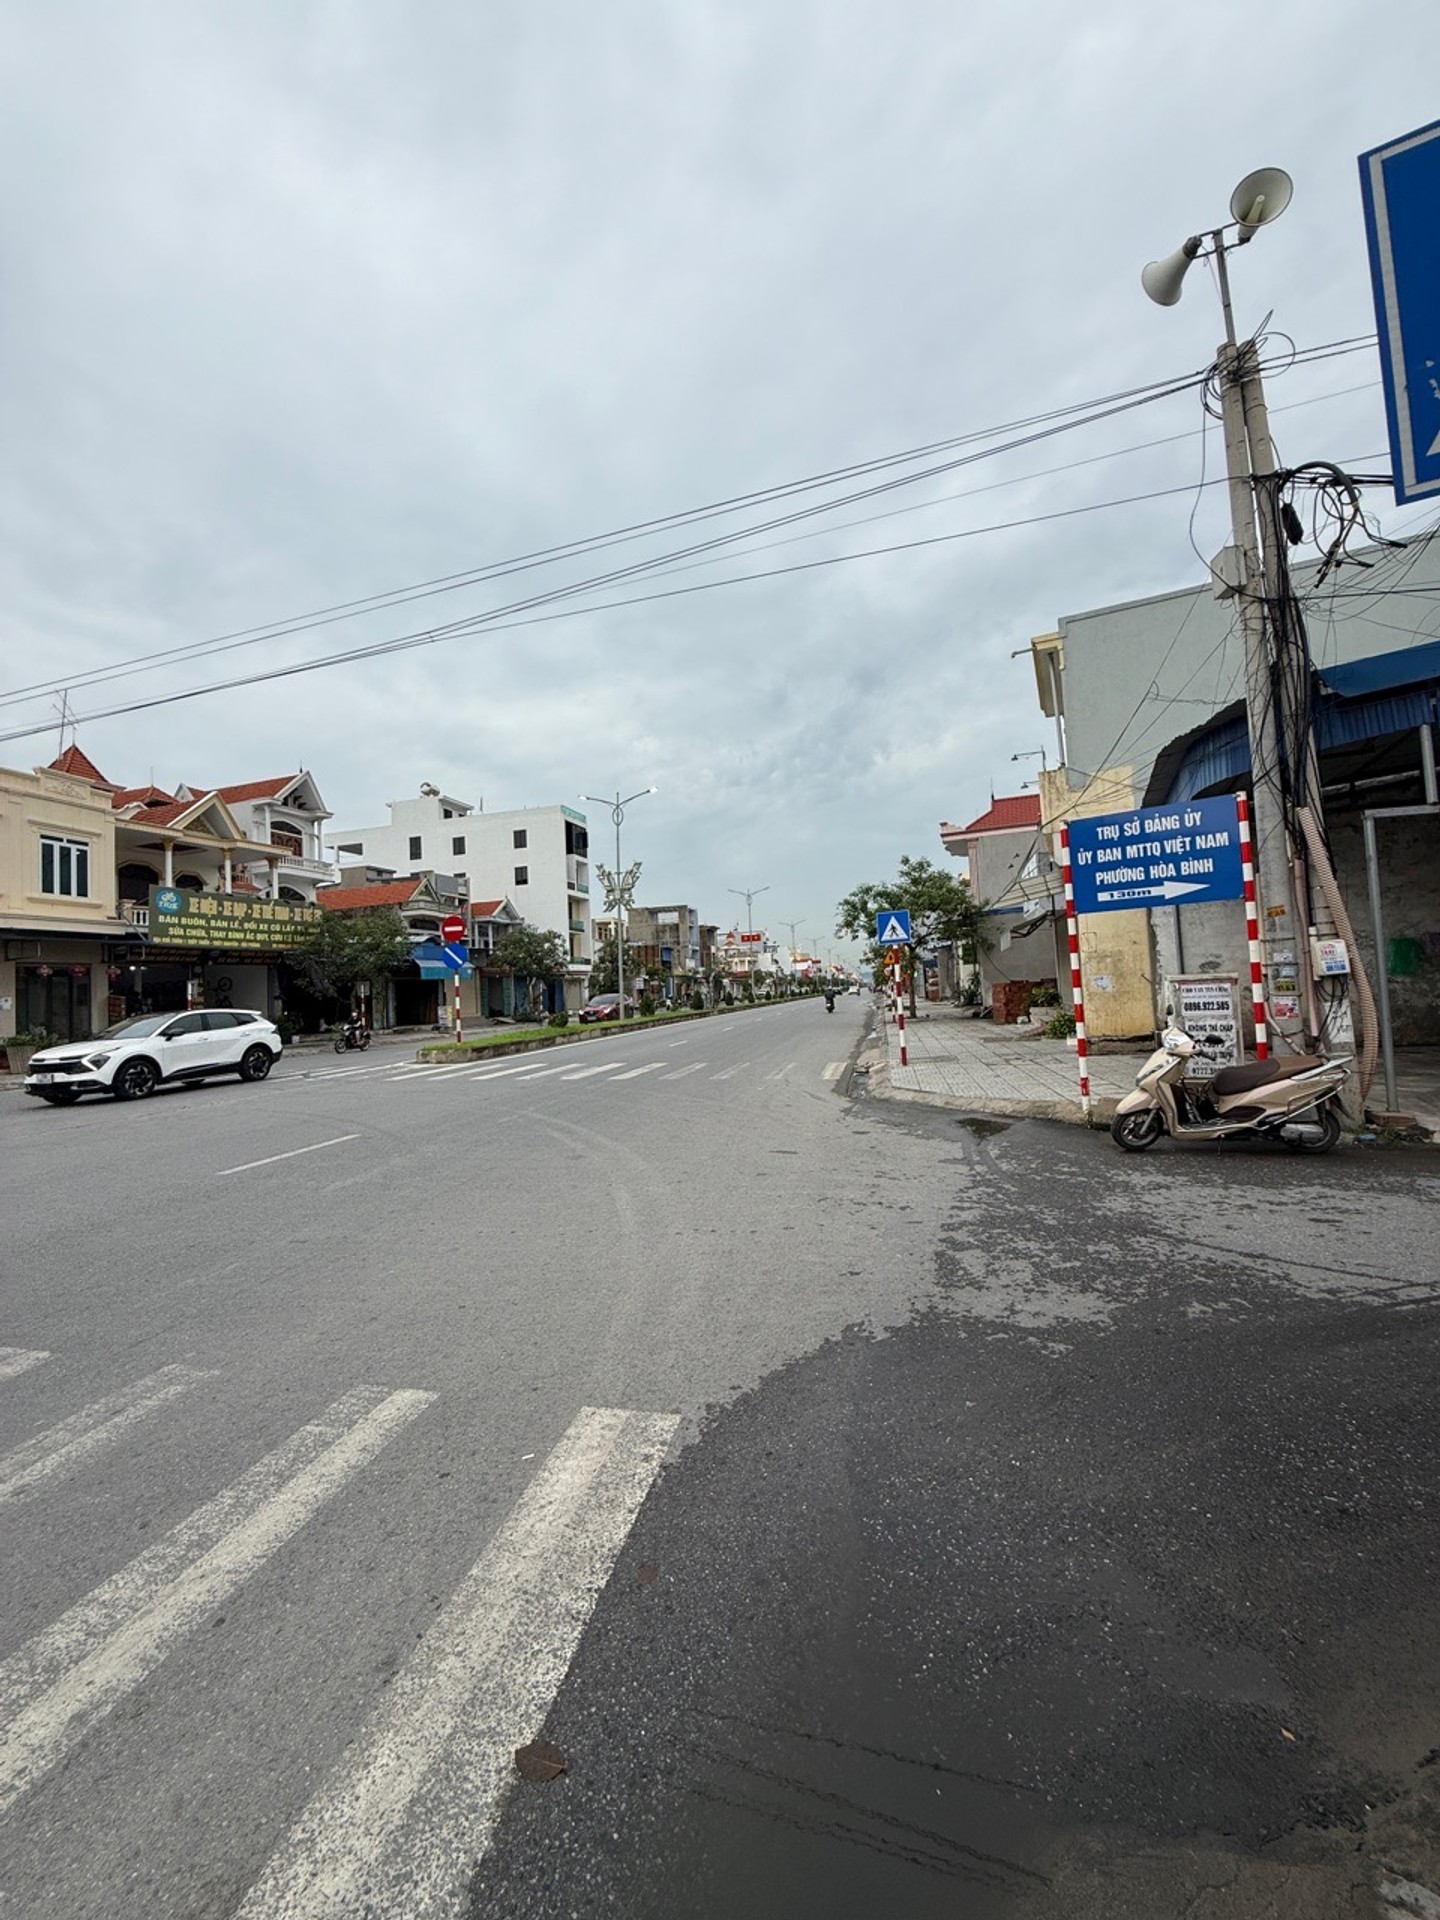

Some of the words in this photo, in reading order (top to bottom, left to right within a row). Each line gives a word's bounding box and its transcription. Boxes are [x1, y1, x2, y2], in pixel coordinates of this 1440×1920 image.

[1097, 826, 1119, 841] TRỤ
[1124, 816, 1141, 836] SỞ
[1145, 814, 1180, 833] ĐẢNG
[1185, 808, 1201, 827] ỦY
[1077, 848, 1093, 865] ỦY
[1097, 847, 1121, 863] BAN
[1126, 843, 1161, 859] MTTQ
[1163, 835, 1191, 855] VIỆT
[1195, 832, 1229, 850] NAM
[1095, 866, 1145, 885] PHƯỜNG
[1150, 861, 1176, 879] HÒA
[1181, 857, 1213, 875] BÌNH
[1109, 889, 1151, 899] 130m
